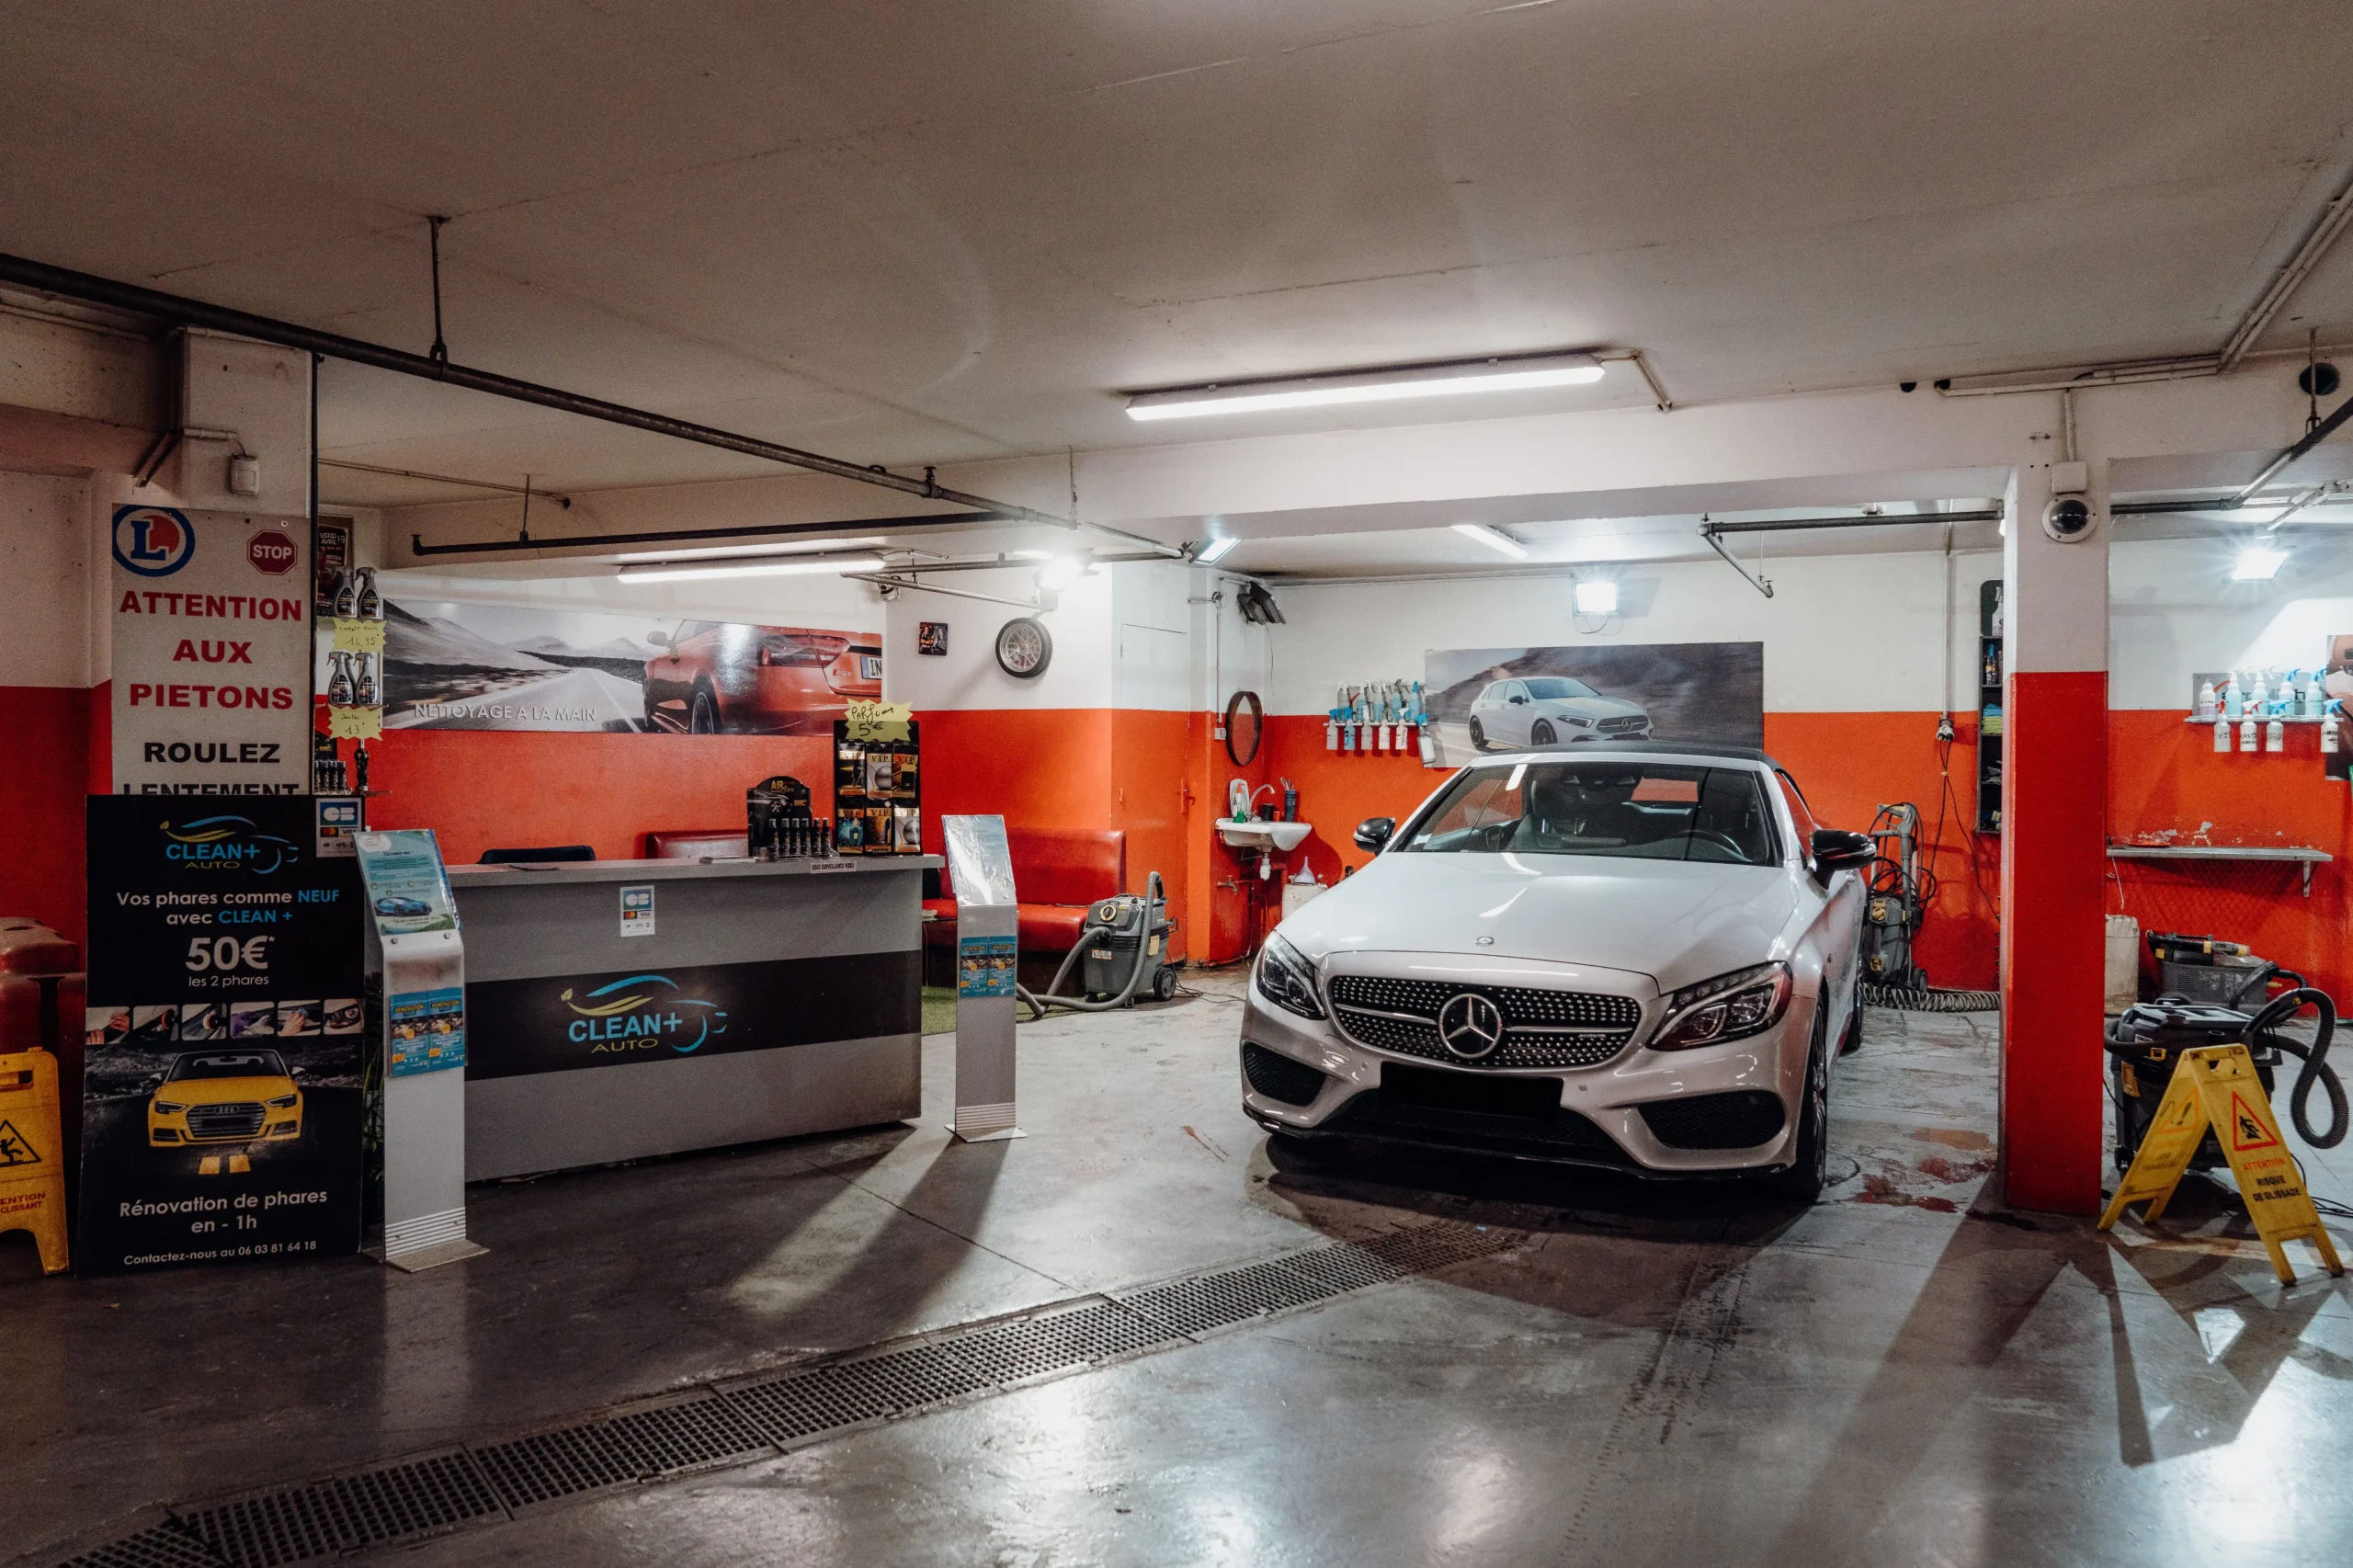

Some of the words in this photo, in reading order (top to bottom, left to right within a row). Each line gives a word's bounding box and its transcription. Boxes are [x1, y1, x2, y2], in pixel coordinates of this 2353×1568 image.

[253, 543, 291, 560] STOP
[119, 591, 301, 621] ATTENTION
[173, 640, 253, 664] AUX
[130, 684, 293, 710] PIETONS
[414, 703, 511, 720] NETTOYAGE
[516, 706, 528, 720] A
[532, 707, 551, 721] LA
[555, 708, 597, 722] MAIN
[858, 722, 883, 736] 5€
[144, 743, 280, 763] ROULEZ
[771, 780, 784, 790] AIR
[165, 844, 260, 859] CLEAN+
[117, 892, 150, 905] Vos
[156, 892, 218, 908] phares
[223, 892, 292, 904] comme
[298, 890, 340, 903] NEUF
[166, 914, 212, 925] avec
[218, 910, 276, 924] CLEAN
[188, 976, 207, 987] les
[210, 976, 220, 986] 2
[222, 974, 269, 988] phares
[568, 1012, 683, 1042] CLEAN+
[591, 1038, 658, 1054] AUTO
[2244, 1157, 2285, 1170] ATTENTION
[2256, 1176, 2286, 1186] RISQUE
[2253, 1193, 2264, 1201] DE
[2264, 1187, 2301, 1199] GLISSADE
[119, 1197, 228, 1217] Rénovation
[233, 1194, 258, 1209] de
[265, 1190, 327, 1210] phares
[191, 1220, 215, 1233] en
[236, 1215, 257, 1230] 1h
[124, 1249, 217, 1266] Contactez-nous
[221, 1249, 235, 1257] au
[238, 1246, 252, 1256] 06
[255, 1244, 268, 1255] 03
[270, 1244, 283, 1253] 81
[287, 1242, 301, 1252] 64
[303, 1241, 317, 1250] 18
